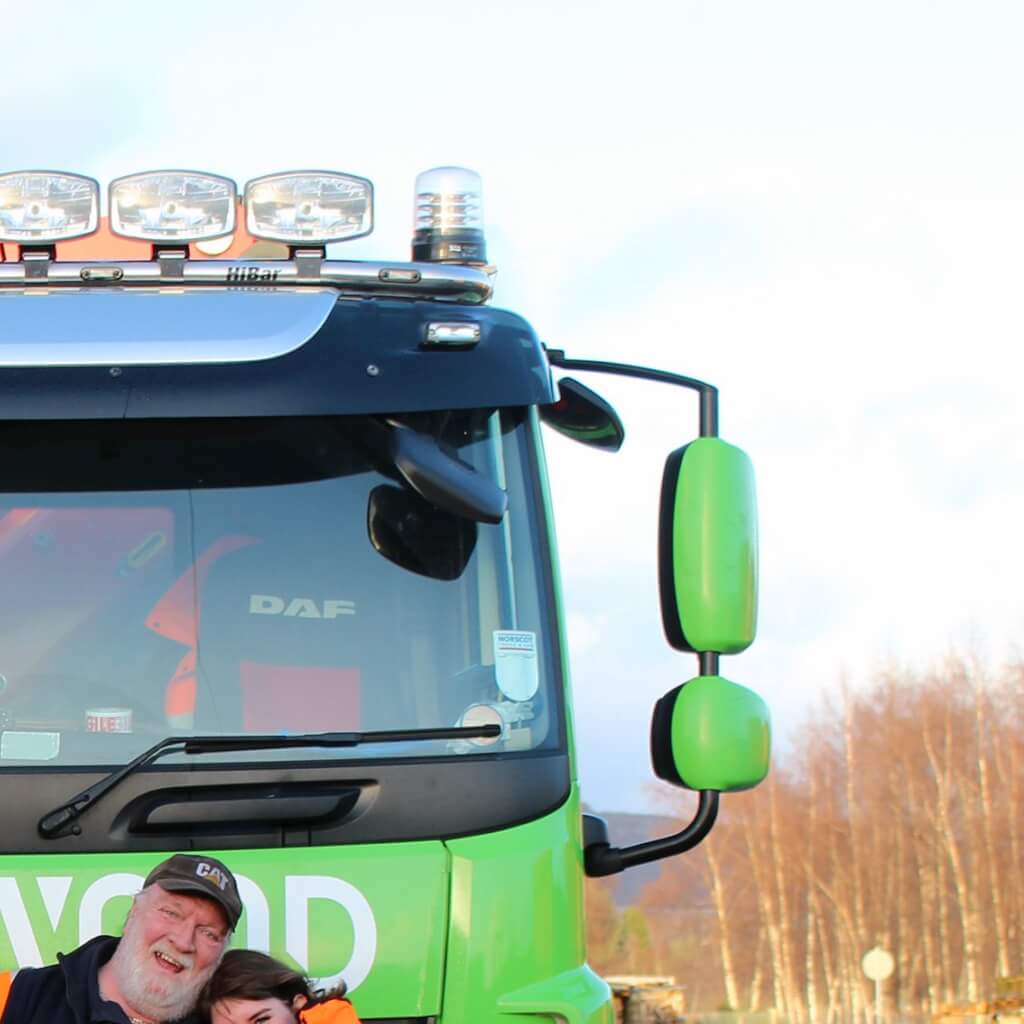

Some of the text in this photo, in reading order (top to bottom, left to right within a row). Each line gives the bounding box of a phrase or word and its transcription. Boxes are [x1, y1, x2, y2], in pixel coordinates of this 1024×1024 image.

[226, 266, 281, 281] HiBar
[249, 594, 355, 619] DAF
[196, 862, 229, 890] CAT
